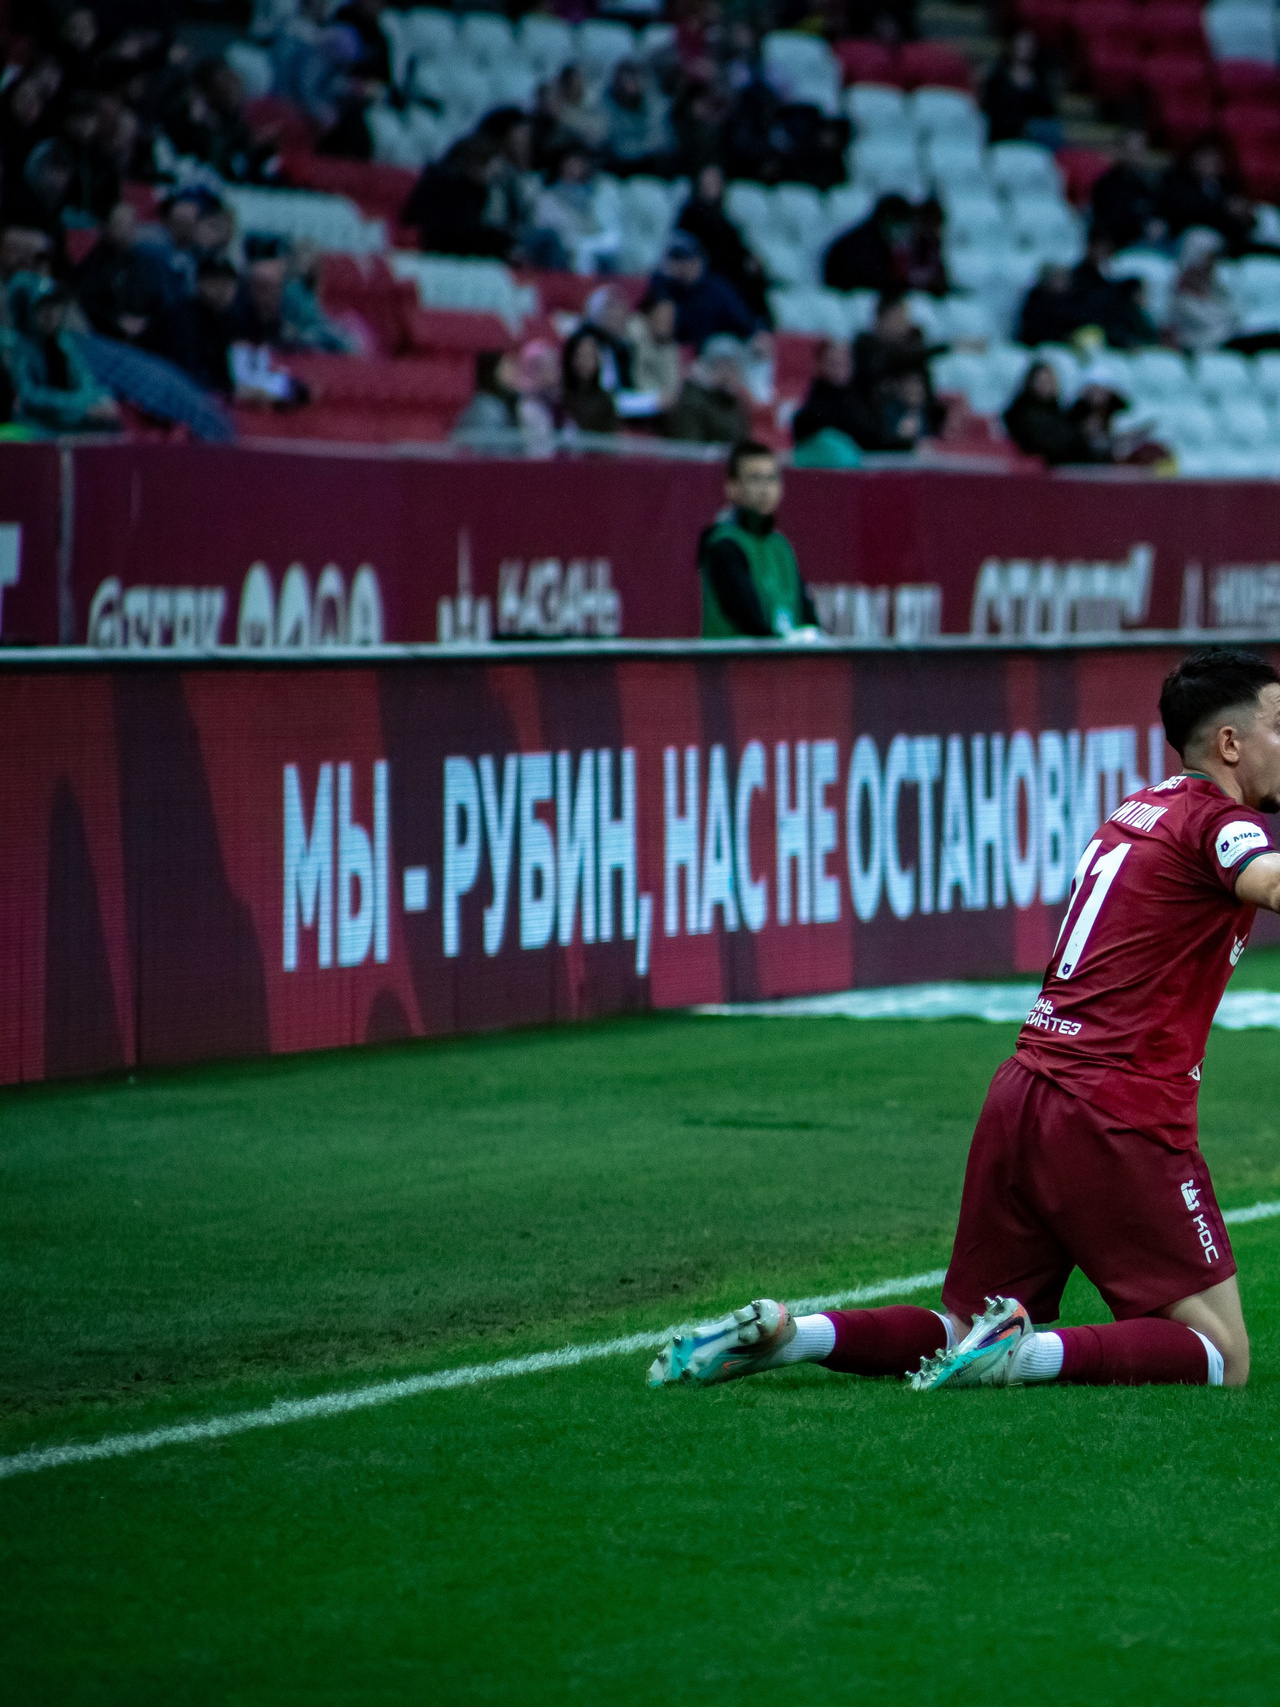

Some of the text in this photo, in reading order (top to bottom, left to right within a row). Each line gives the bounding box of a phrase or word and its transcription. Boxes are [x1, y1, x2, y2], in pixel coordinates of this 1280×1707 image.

[284, 760, 389, 972] МЫ
[443, 746, 653, 977] РУБИН,
[664, 739, 767, 937] НАС
[775, 739, 841, 926] НЕ
